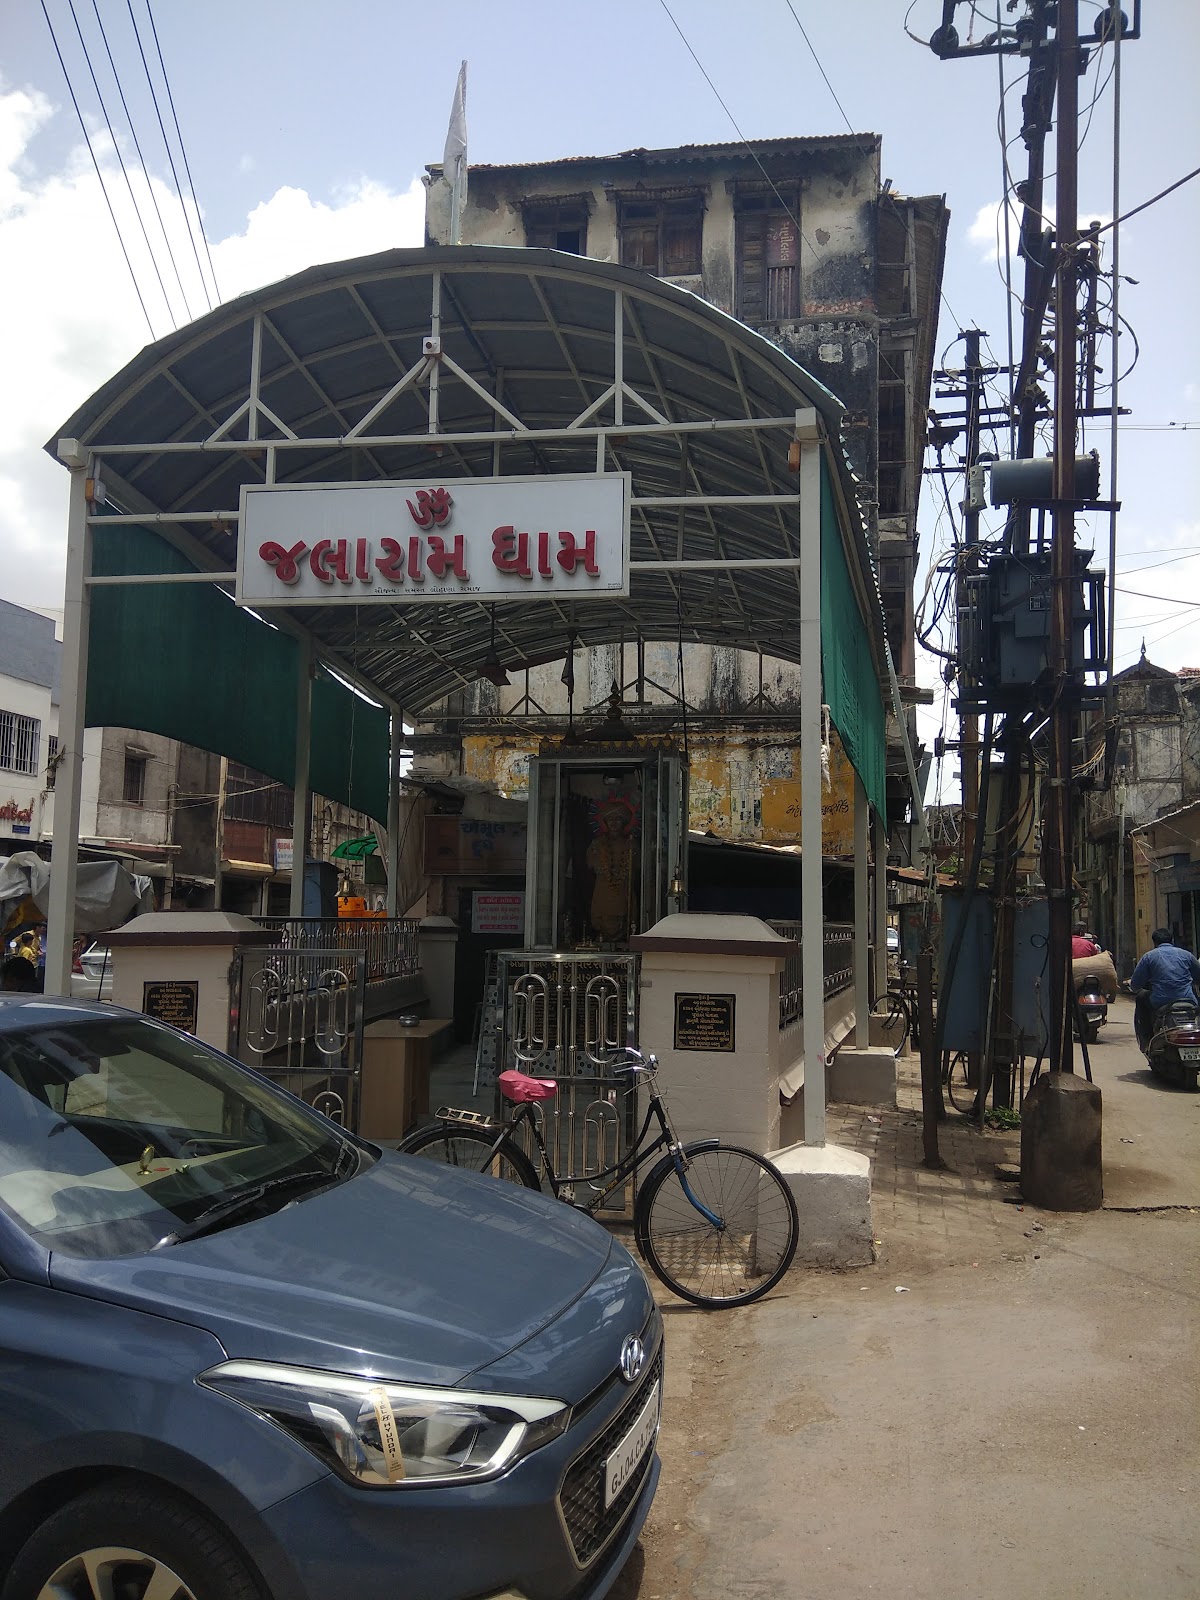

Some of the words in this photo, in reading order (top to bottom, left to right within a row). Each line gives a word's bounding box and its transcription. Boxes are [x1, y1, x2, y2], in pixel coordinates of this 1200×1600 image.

[258, 533, 471, 585] જલારામ
[491, 524, 600, 579] ધામ
[383, 1422, 396, 1458] HYUNDAI
